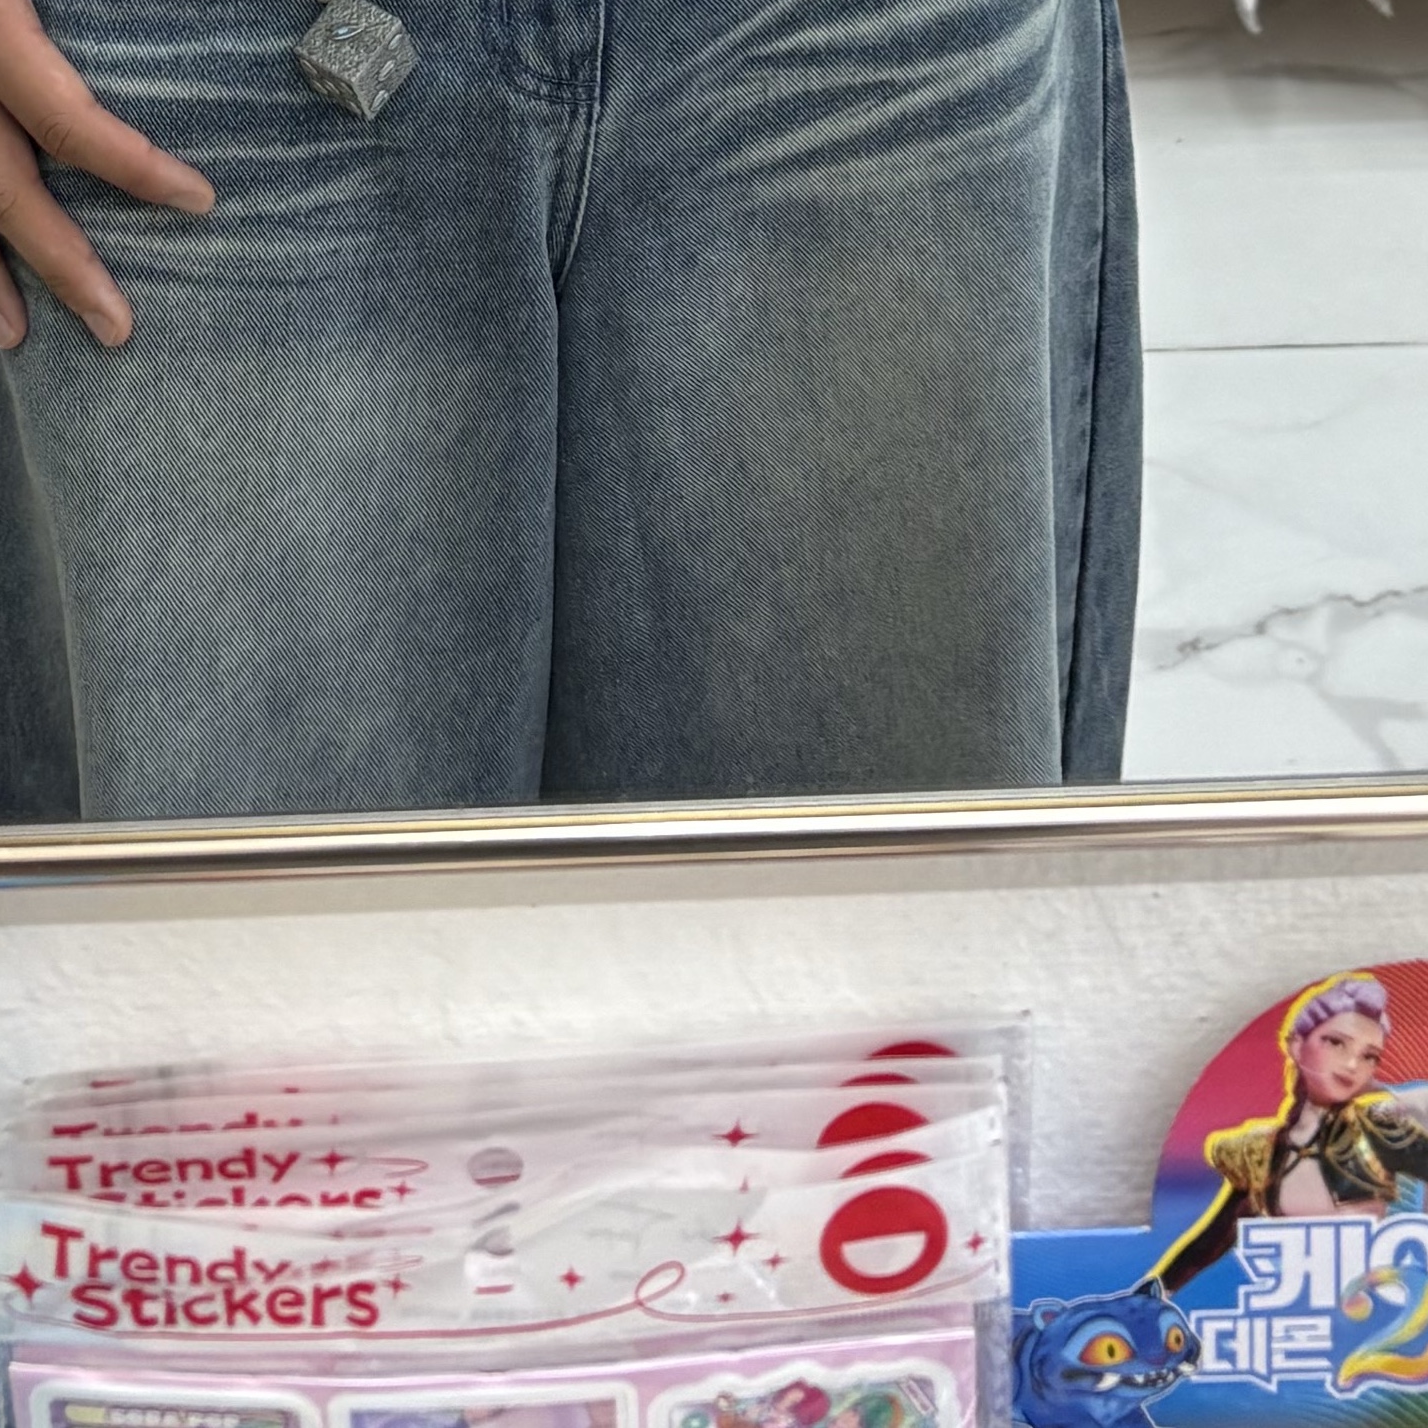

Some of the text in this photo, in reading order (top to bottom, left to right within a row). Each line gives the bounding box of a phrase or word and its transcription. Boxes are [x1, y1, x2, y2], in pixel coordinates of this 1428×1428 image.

[47, 1147, 300, 1191] Trendy
[40, 1219, 292, 1285] Trendy
[72, 1280, 381, 1328] Stickers
[1201, 1316, 1334, 1374] 데몬
